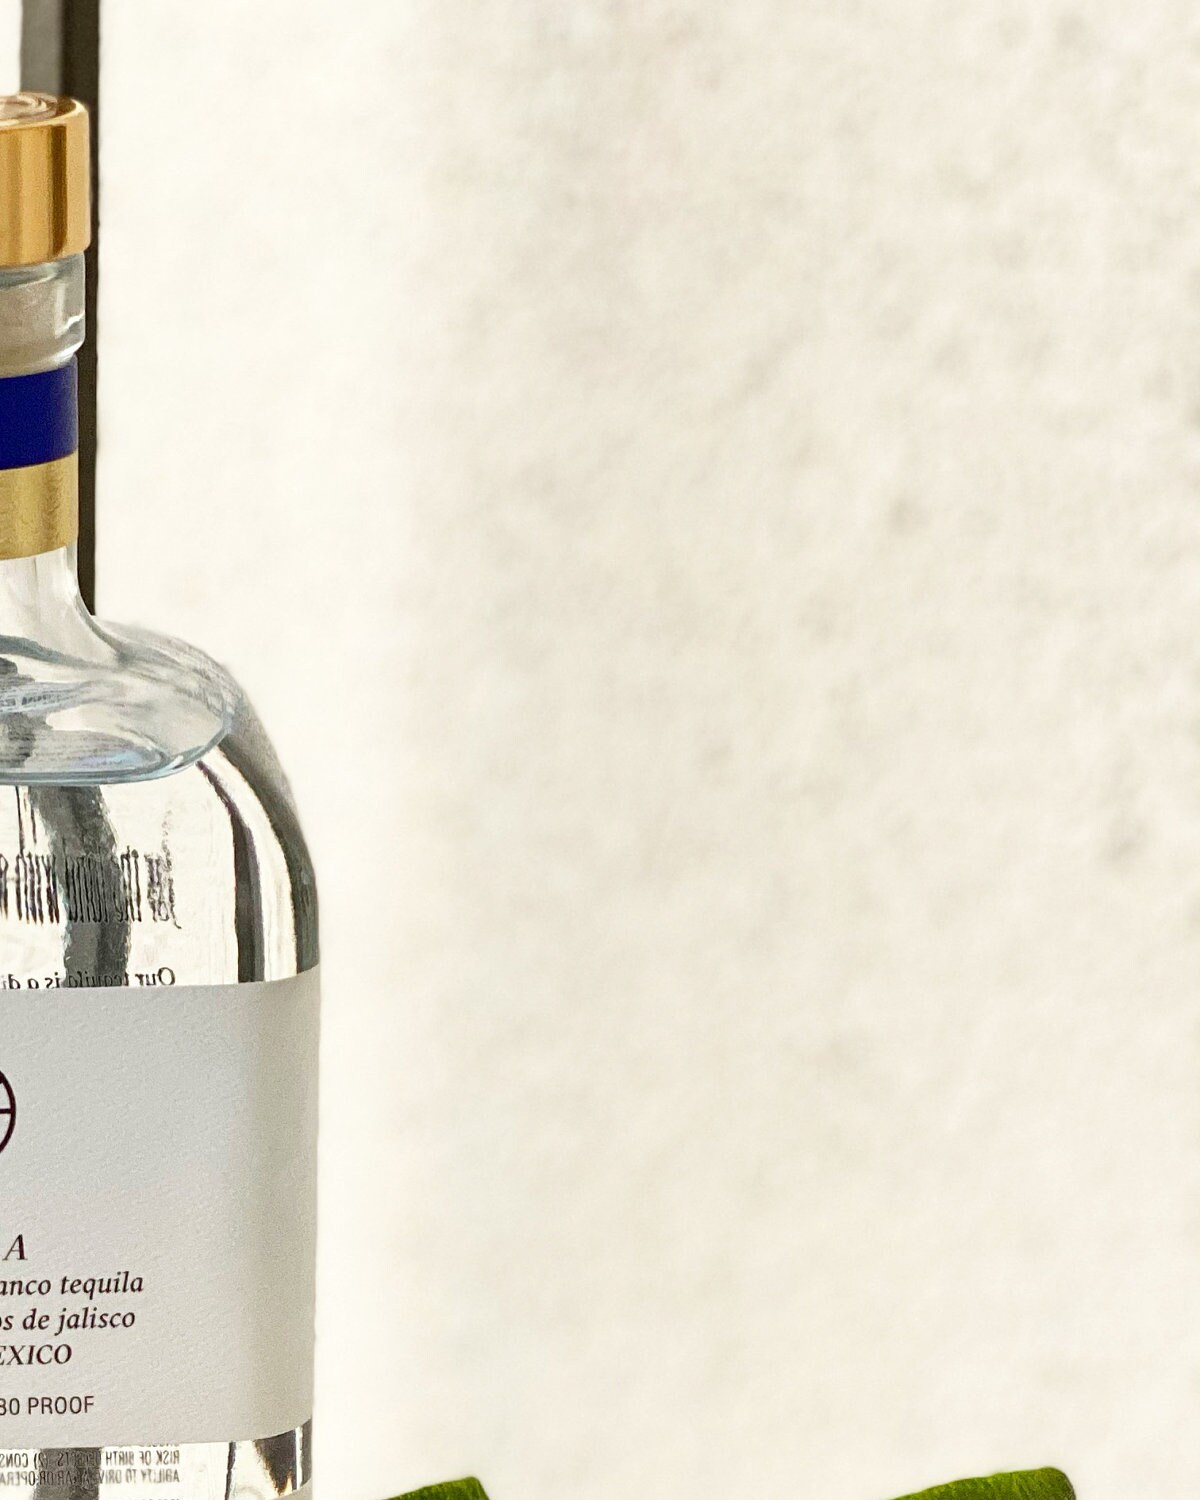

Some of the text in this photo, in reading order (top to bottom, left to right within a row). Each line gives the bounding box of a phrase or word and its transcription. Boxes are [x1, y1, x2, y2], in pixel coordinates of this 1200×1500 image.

[60, 1271, 144, 1300] tequila
[21, 1308, 50, 1331] de
[54, 1306, 136, 1336] jalisco
[27, 1395, 95, 1415] PROOF
